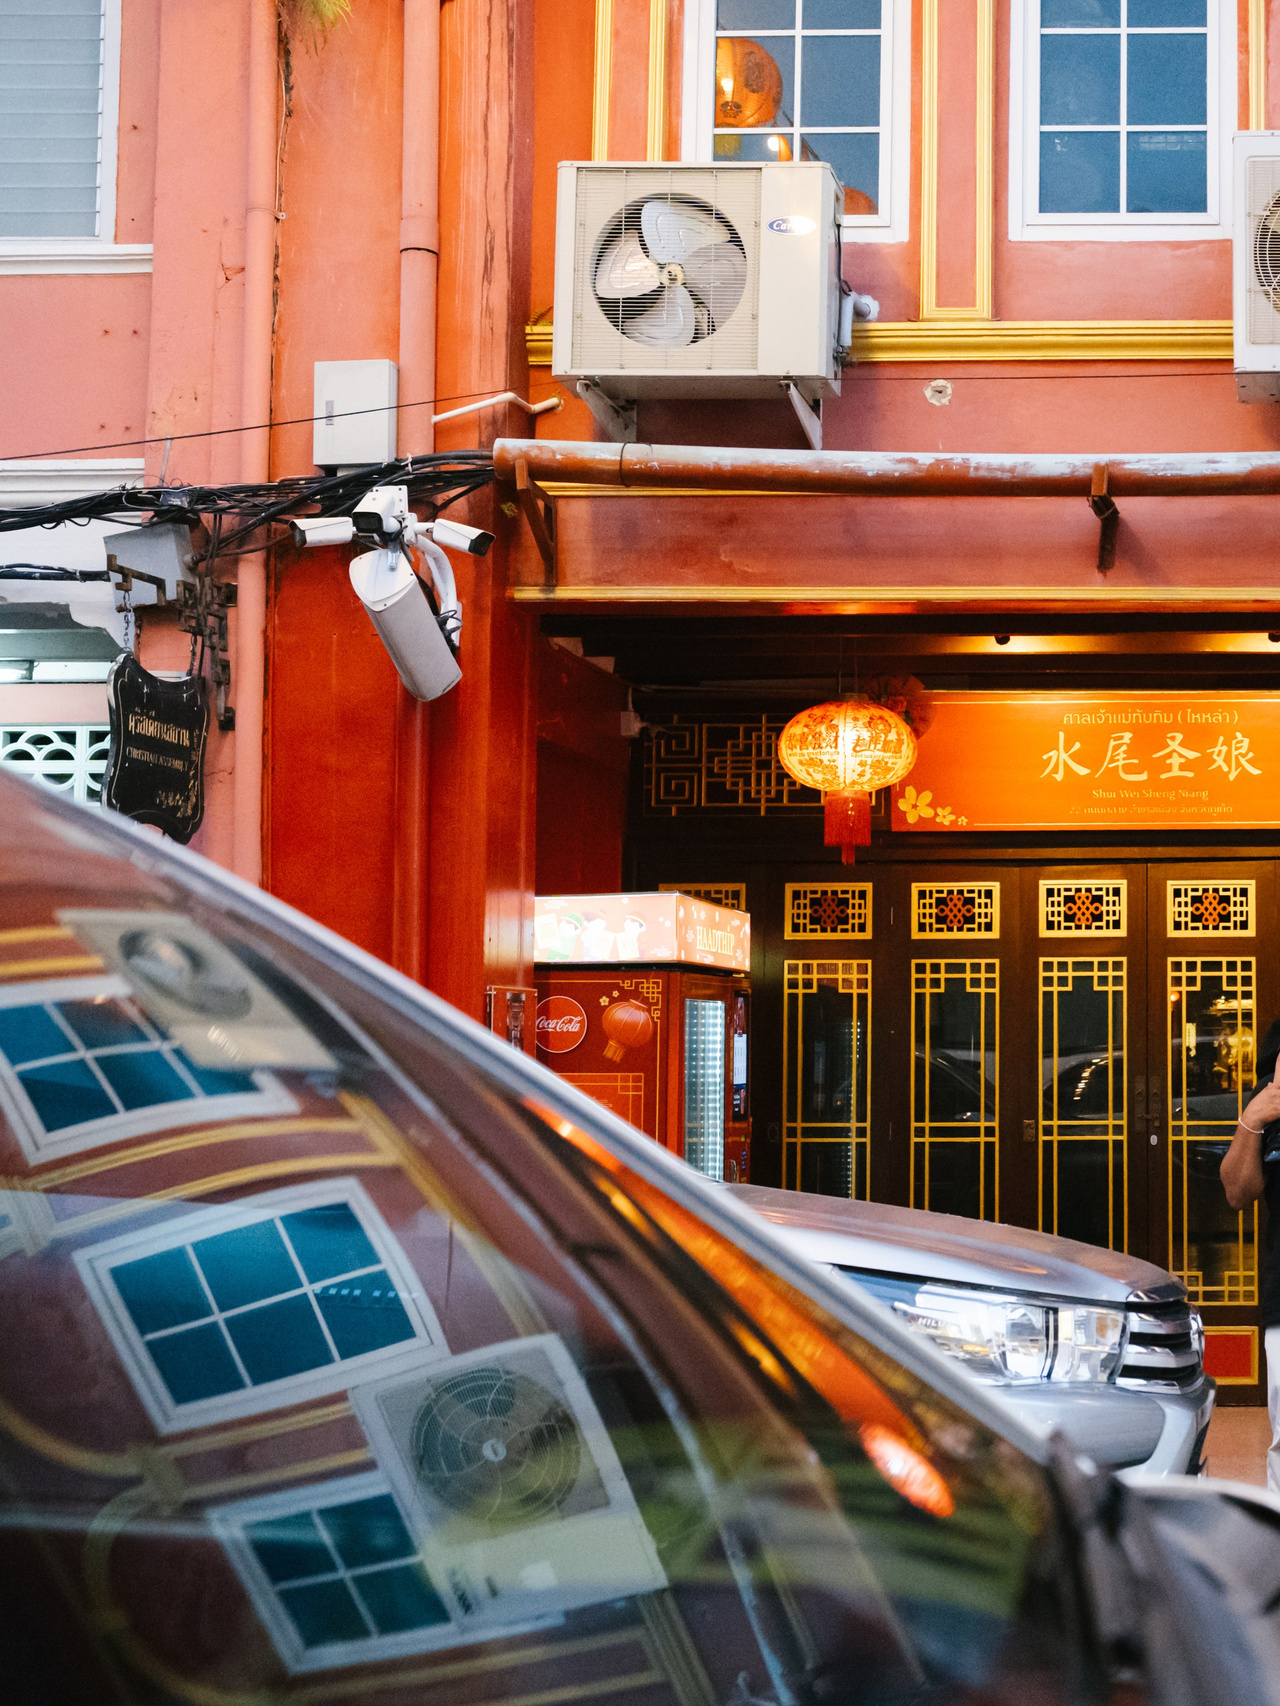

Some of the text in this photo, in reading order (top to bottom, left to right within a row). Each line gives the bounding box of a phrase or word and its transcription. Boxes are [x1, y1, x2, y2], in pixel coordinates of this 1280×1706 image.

[1063, 708, 1173, 725] ศาลเจ้าแม่ทับทิม
[126, 746, 189, 771] CHRISTIAN ASSEMBLY
[1039, 730, 1263, 782] 水尾圣娘
[1092, 788, 1209, 801] Shui Wei Sheng Niang
[696, 926, 735, 955] HAADTHIP
[536, 1015, 583, 1032] Coca-Cola
